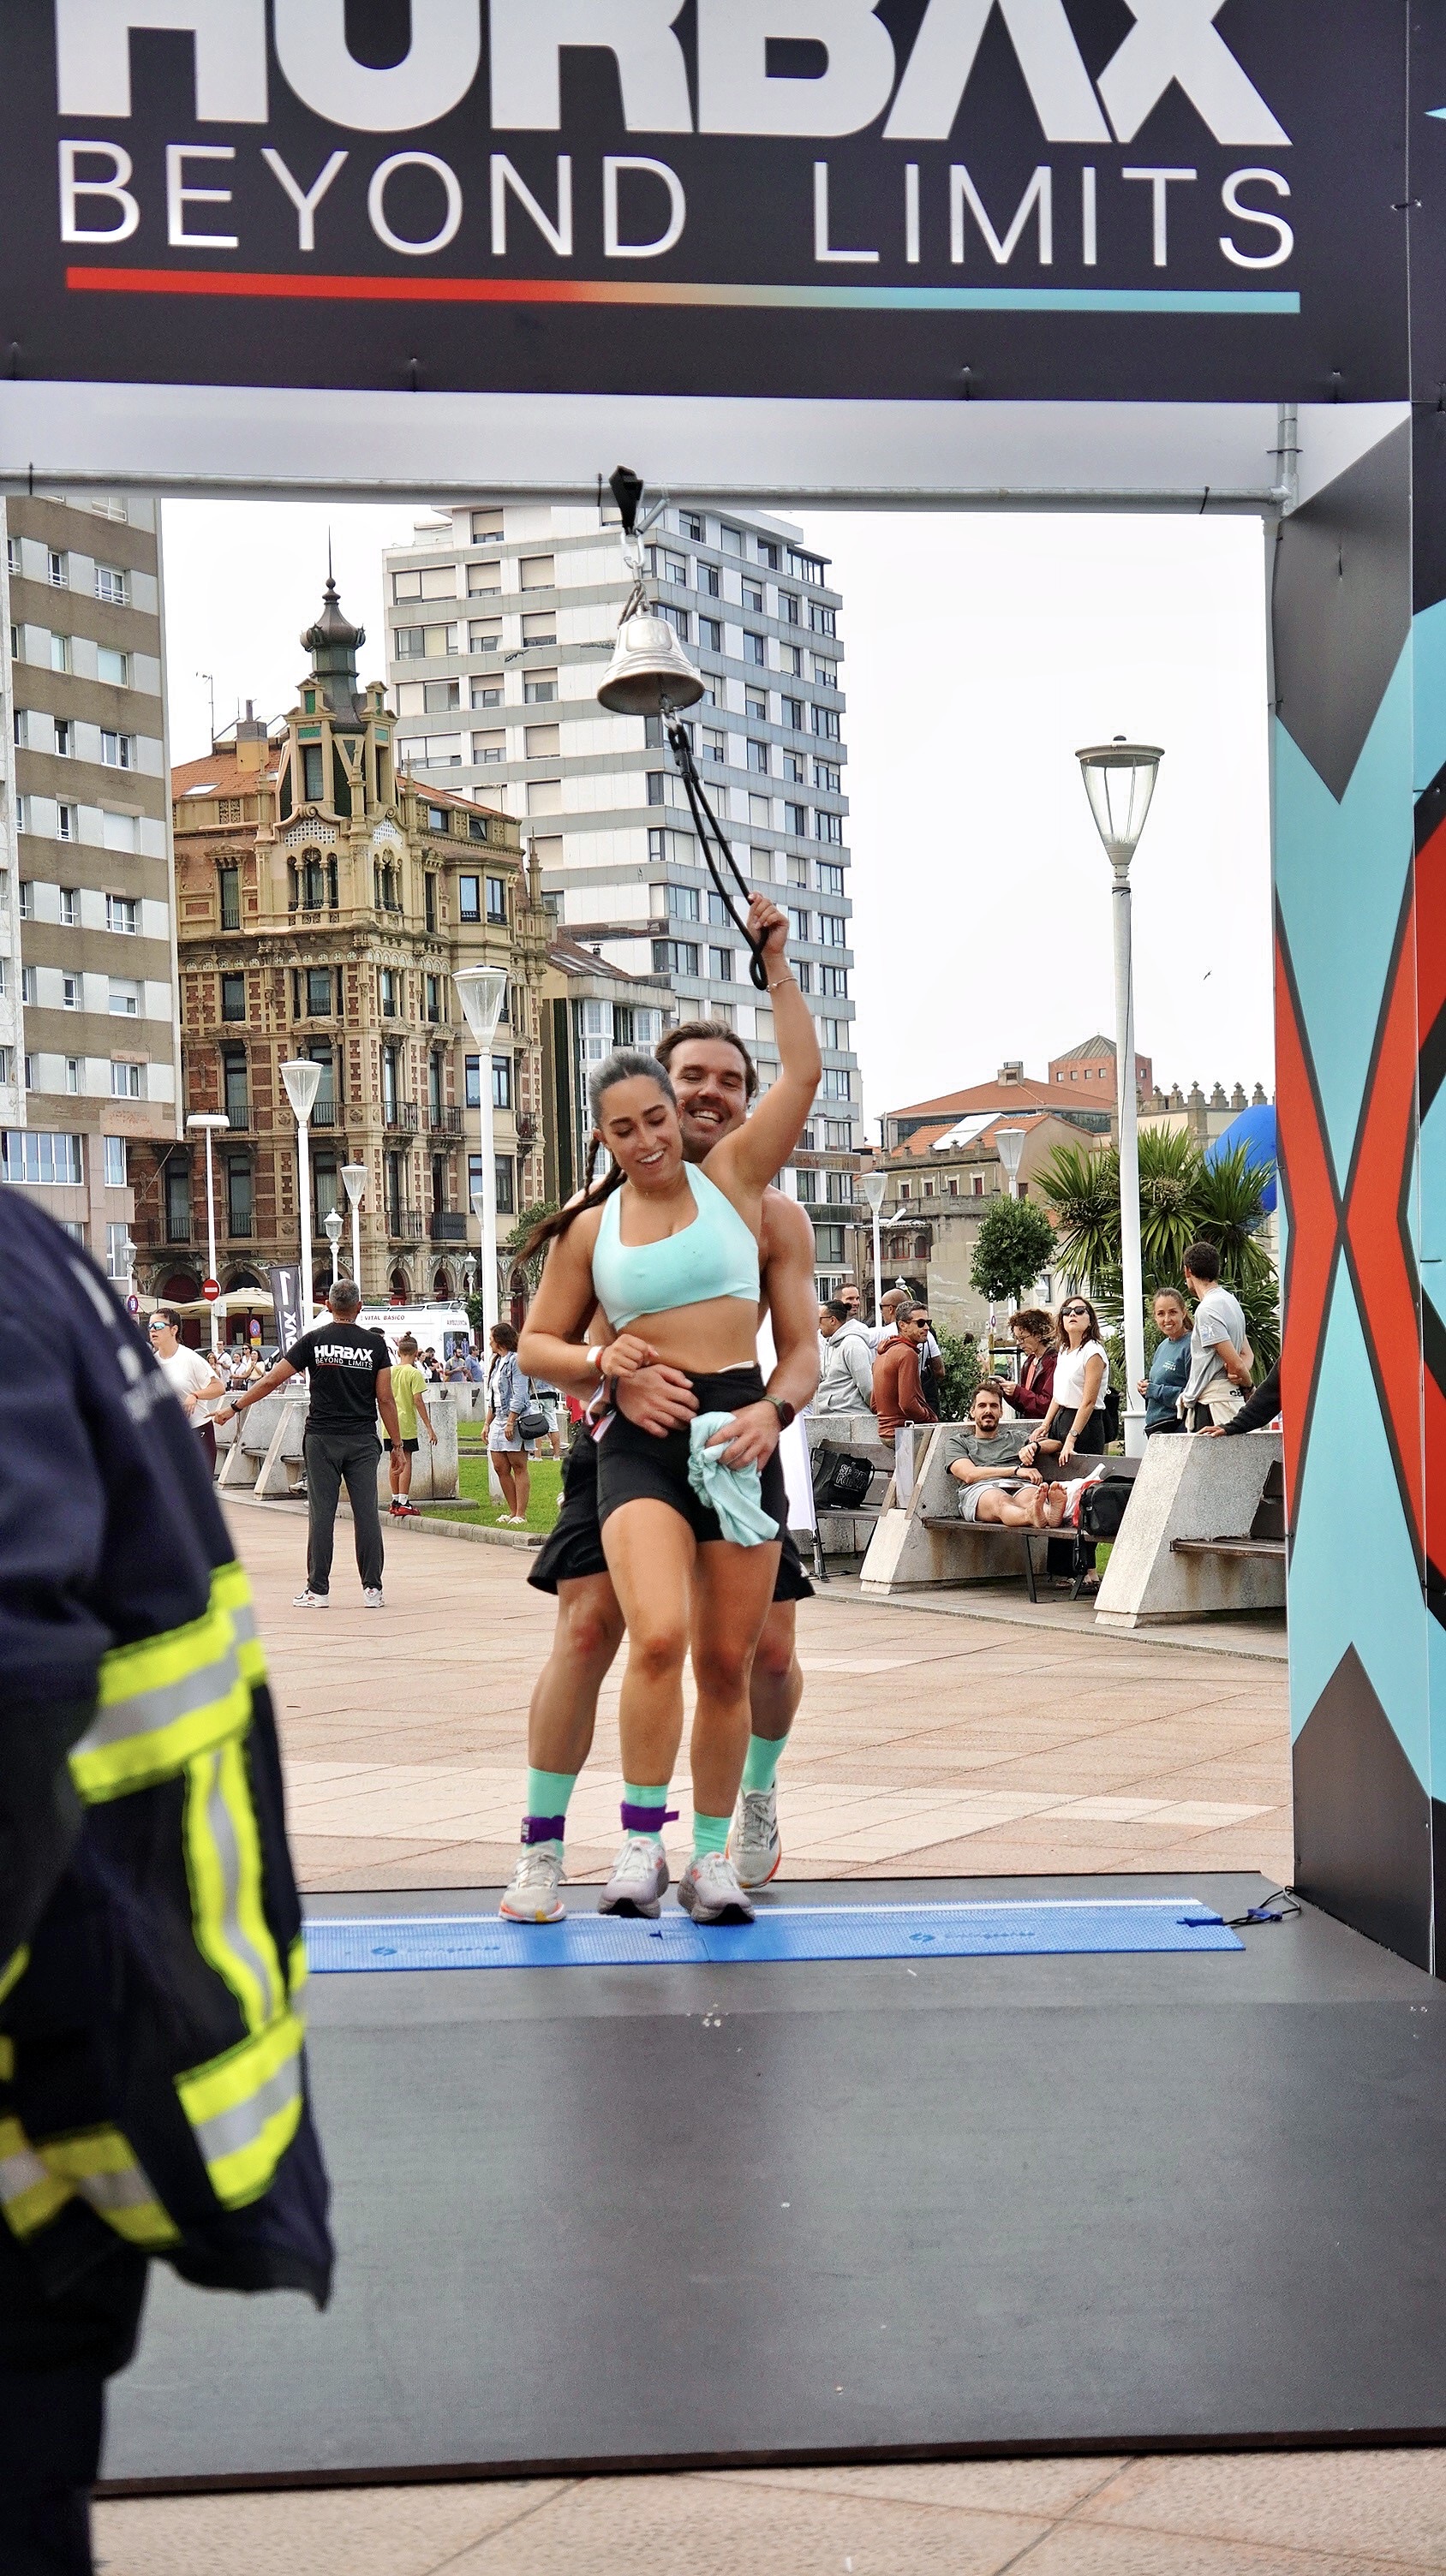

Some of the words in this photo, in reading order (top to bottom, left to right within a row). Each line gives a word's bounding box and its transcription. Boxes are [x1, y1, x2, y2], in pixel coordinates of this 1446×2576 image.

[59, 140, 687, 258] BEYOND
[814, 161, 1294, 269] LIMITS
[314, 1345, 373, 1362] HURBAX
